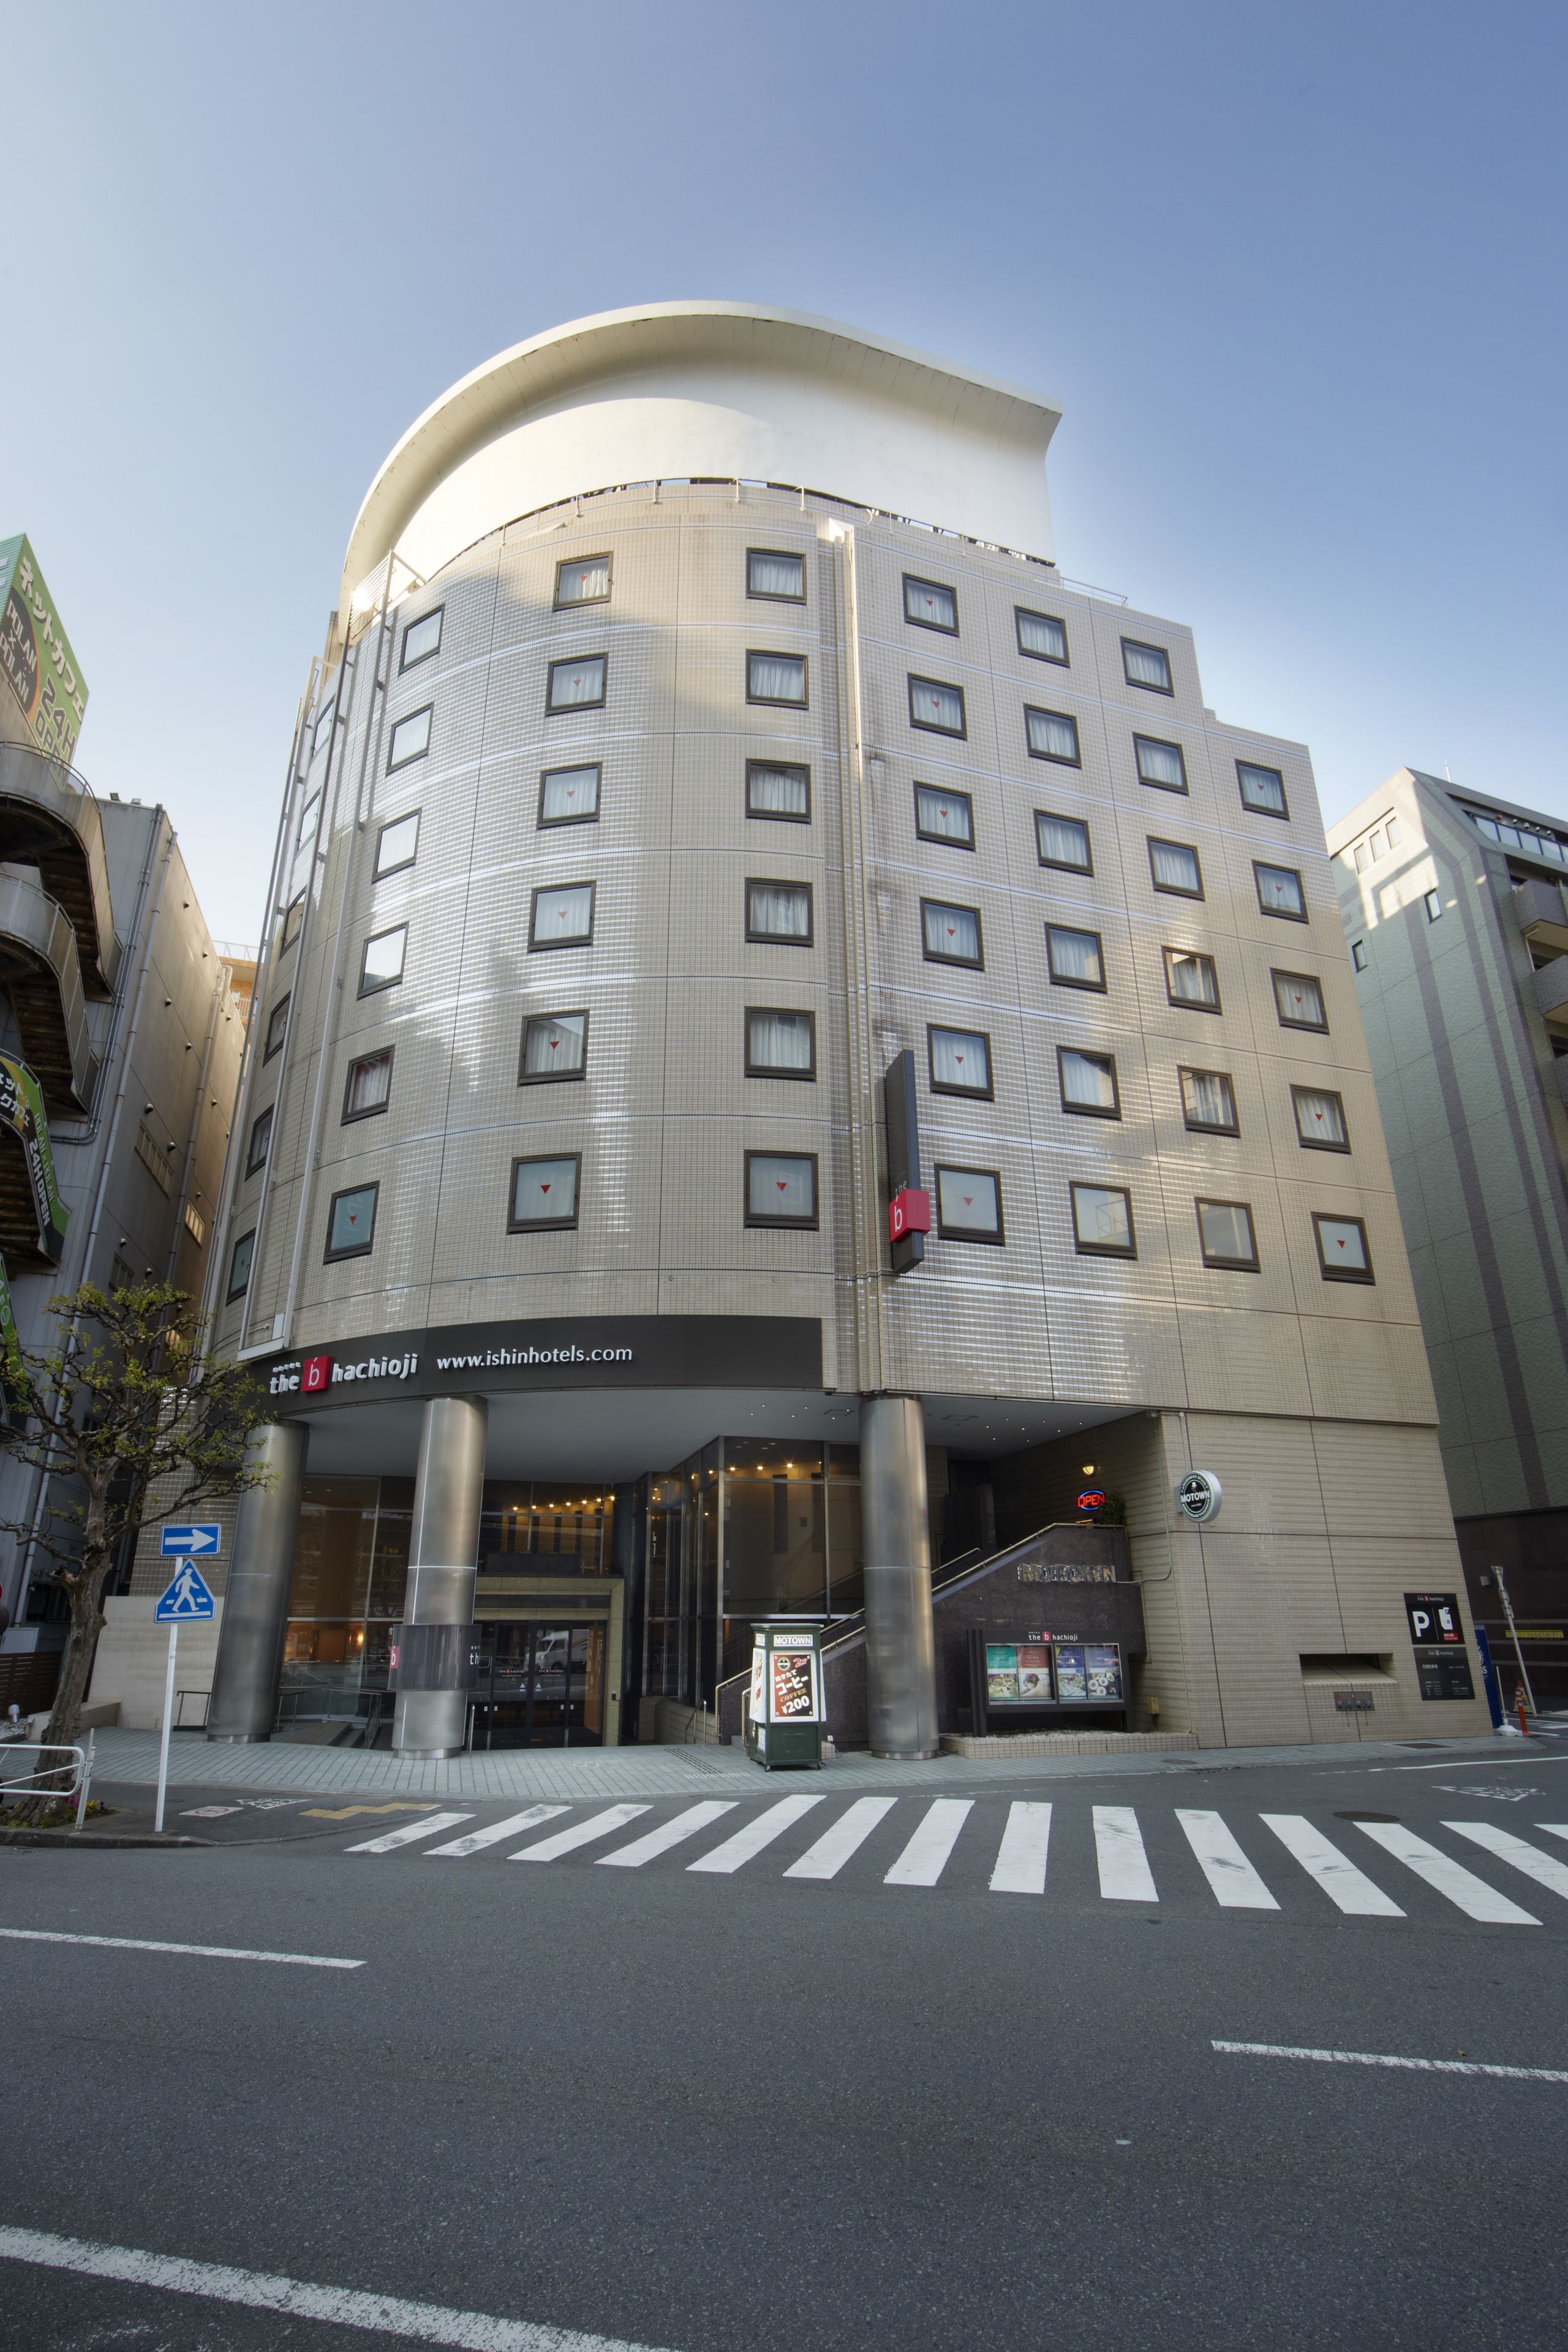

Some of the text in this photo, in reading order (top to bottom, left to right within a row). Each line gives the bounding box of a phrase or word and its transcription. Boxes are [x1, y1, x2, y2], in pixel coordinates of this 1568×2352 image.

[20, 556, 84, 723] ネットカフェ
[40, 673, 77, 769] 24H
[437, 1345, 632, 1369] www.ishinhotels.com
[270, 1374, 300, 1394] the
[332, 1353, 418, 1379] hachioji
[1078, 1494, 1105, 1507] OPEN
[1180, 1490, 1210, 1502] MOTOWN
[1412, 1611, 1430, 1637] P
[774, 1636, 811, 1645] MOTOWN
[776, 1675, 809, 1695] コーヒー
[780, 1687, 807, 1703] COFFEE
[782, 1695, 810, 1714] ¥200
